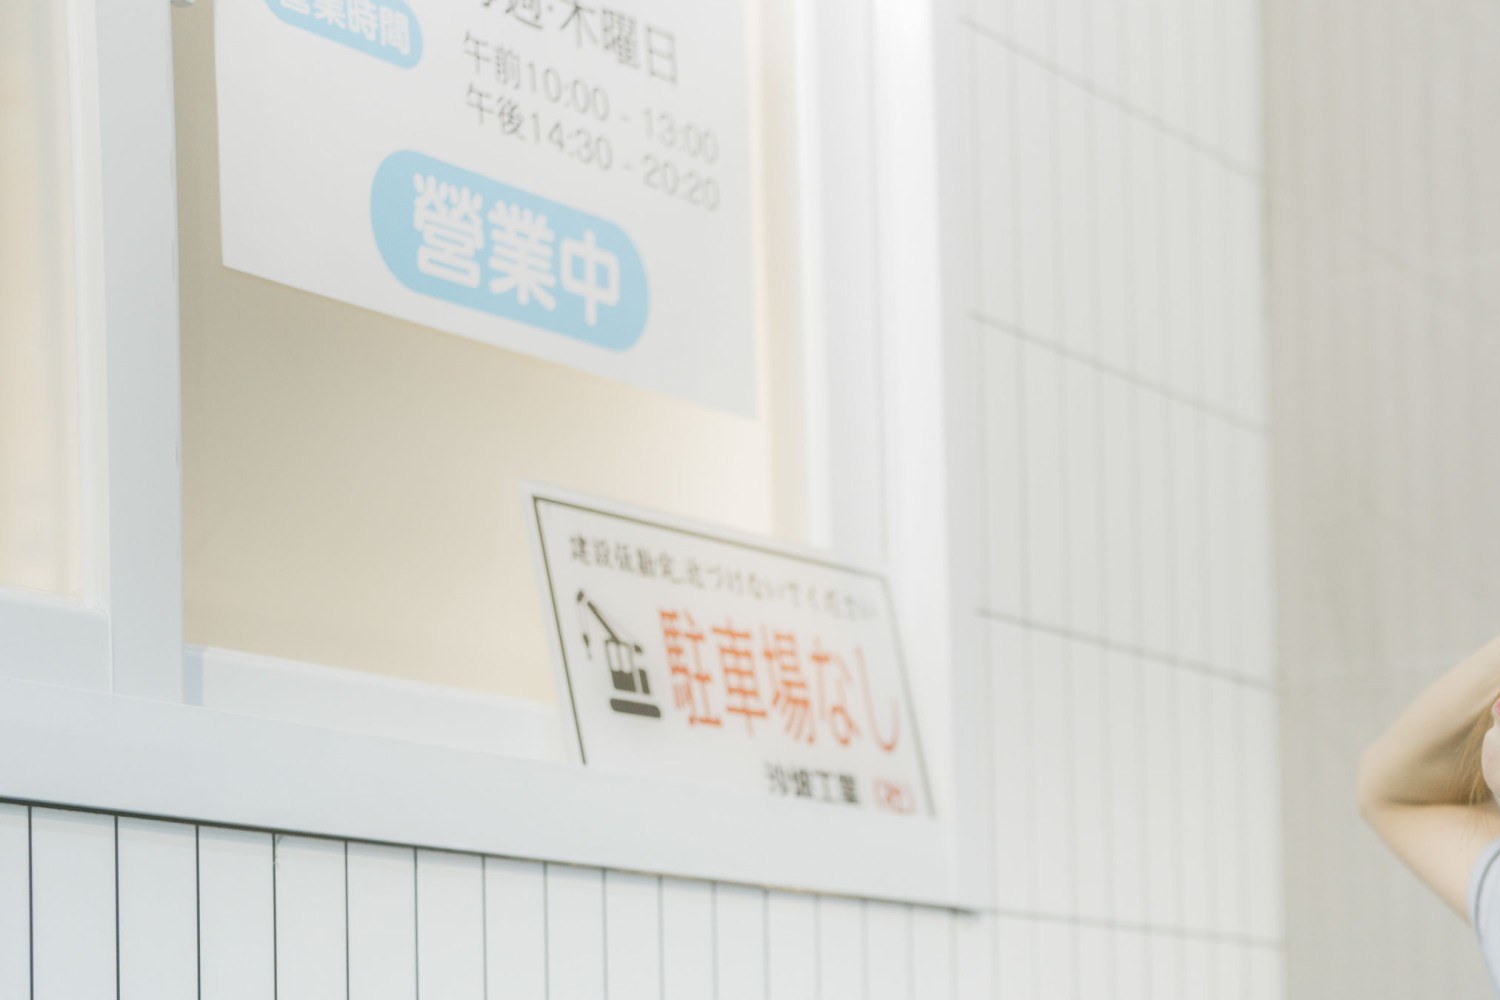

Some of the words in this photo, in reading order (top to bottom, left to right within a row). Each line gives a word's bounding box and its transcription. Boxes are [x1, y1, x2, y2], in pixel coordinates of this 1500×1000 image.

[462, 30, 611, 123] 午前10:00
[642, 107, 722, 167] 13:00
[464, 82, 615, 173] 午後14:30
[641, 152, 722, 213] 20:20
[412, 171, 621, 327] 營業中
[659, 609, 900, 753] 駐車場なし
